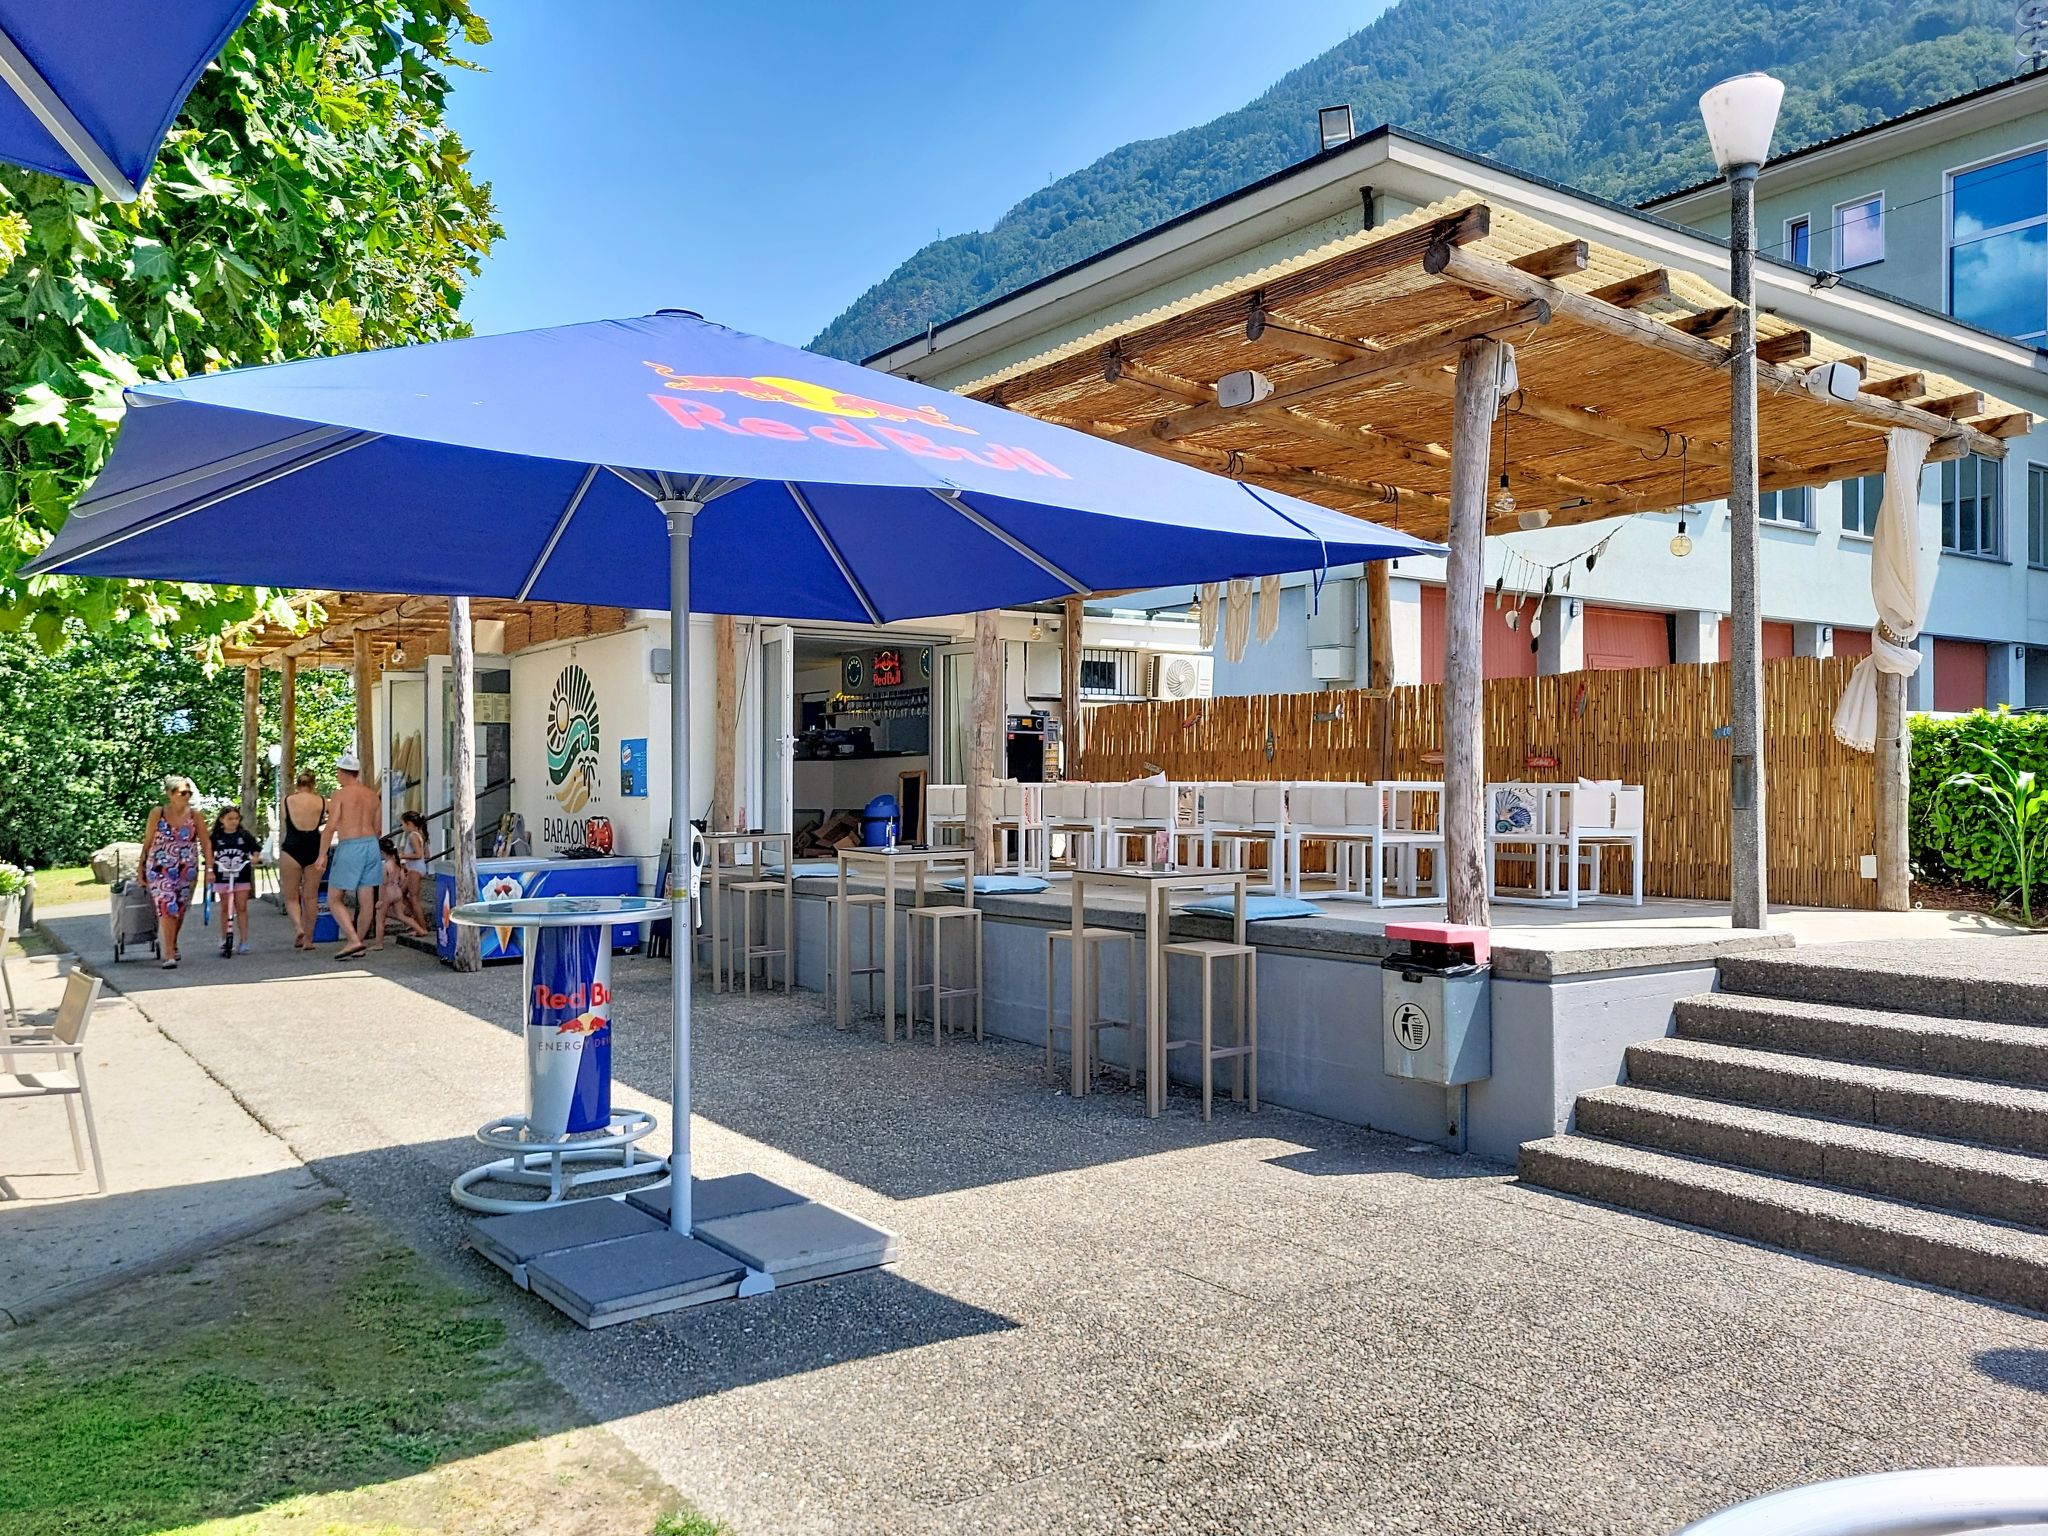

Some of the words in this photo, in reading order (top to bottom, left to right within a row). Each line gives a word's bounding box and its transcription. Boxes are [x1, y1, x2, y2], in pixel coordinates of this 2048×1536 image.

[647, 394, 889, 450] Red
[867, 424, 1073, 480] Bull
[873, 672, 887, 687] Red
[544, 818, 587, 845] BARAON
[535, 982, 586, 1010] Red
[591, 981, 612, 1007] Bu
[538, 1038, 590, 1051] ENERGY
